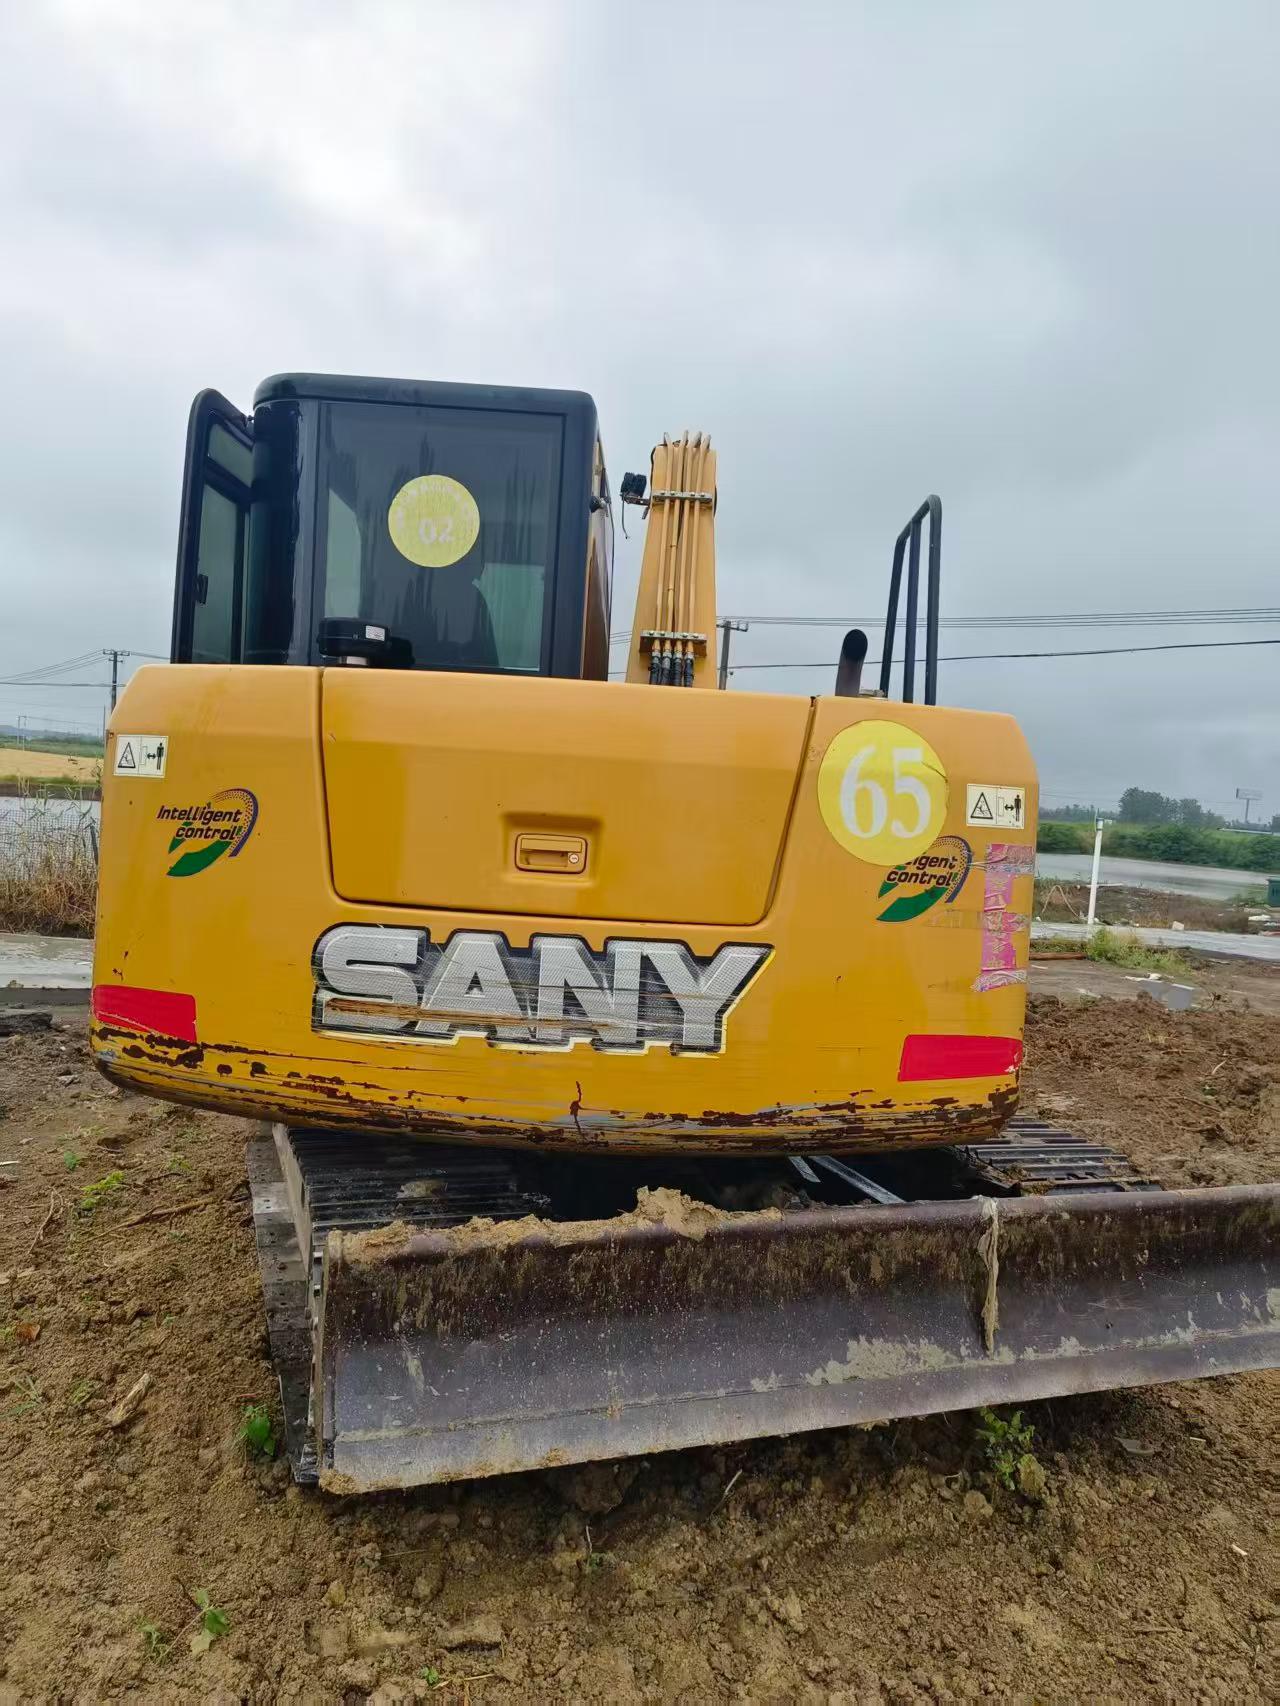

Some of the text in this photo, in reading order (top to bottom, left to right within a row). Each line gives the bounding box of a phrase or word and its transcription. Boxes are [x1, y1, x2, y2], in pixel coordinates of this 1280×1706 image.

[839, 743, 932, 840] 65
[156, 804, 243, 826] Intelligent
[175, 825, 238, 841] control
[886, 870, 952, 887] control
[314, 924, 774, 1051] SANY
